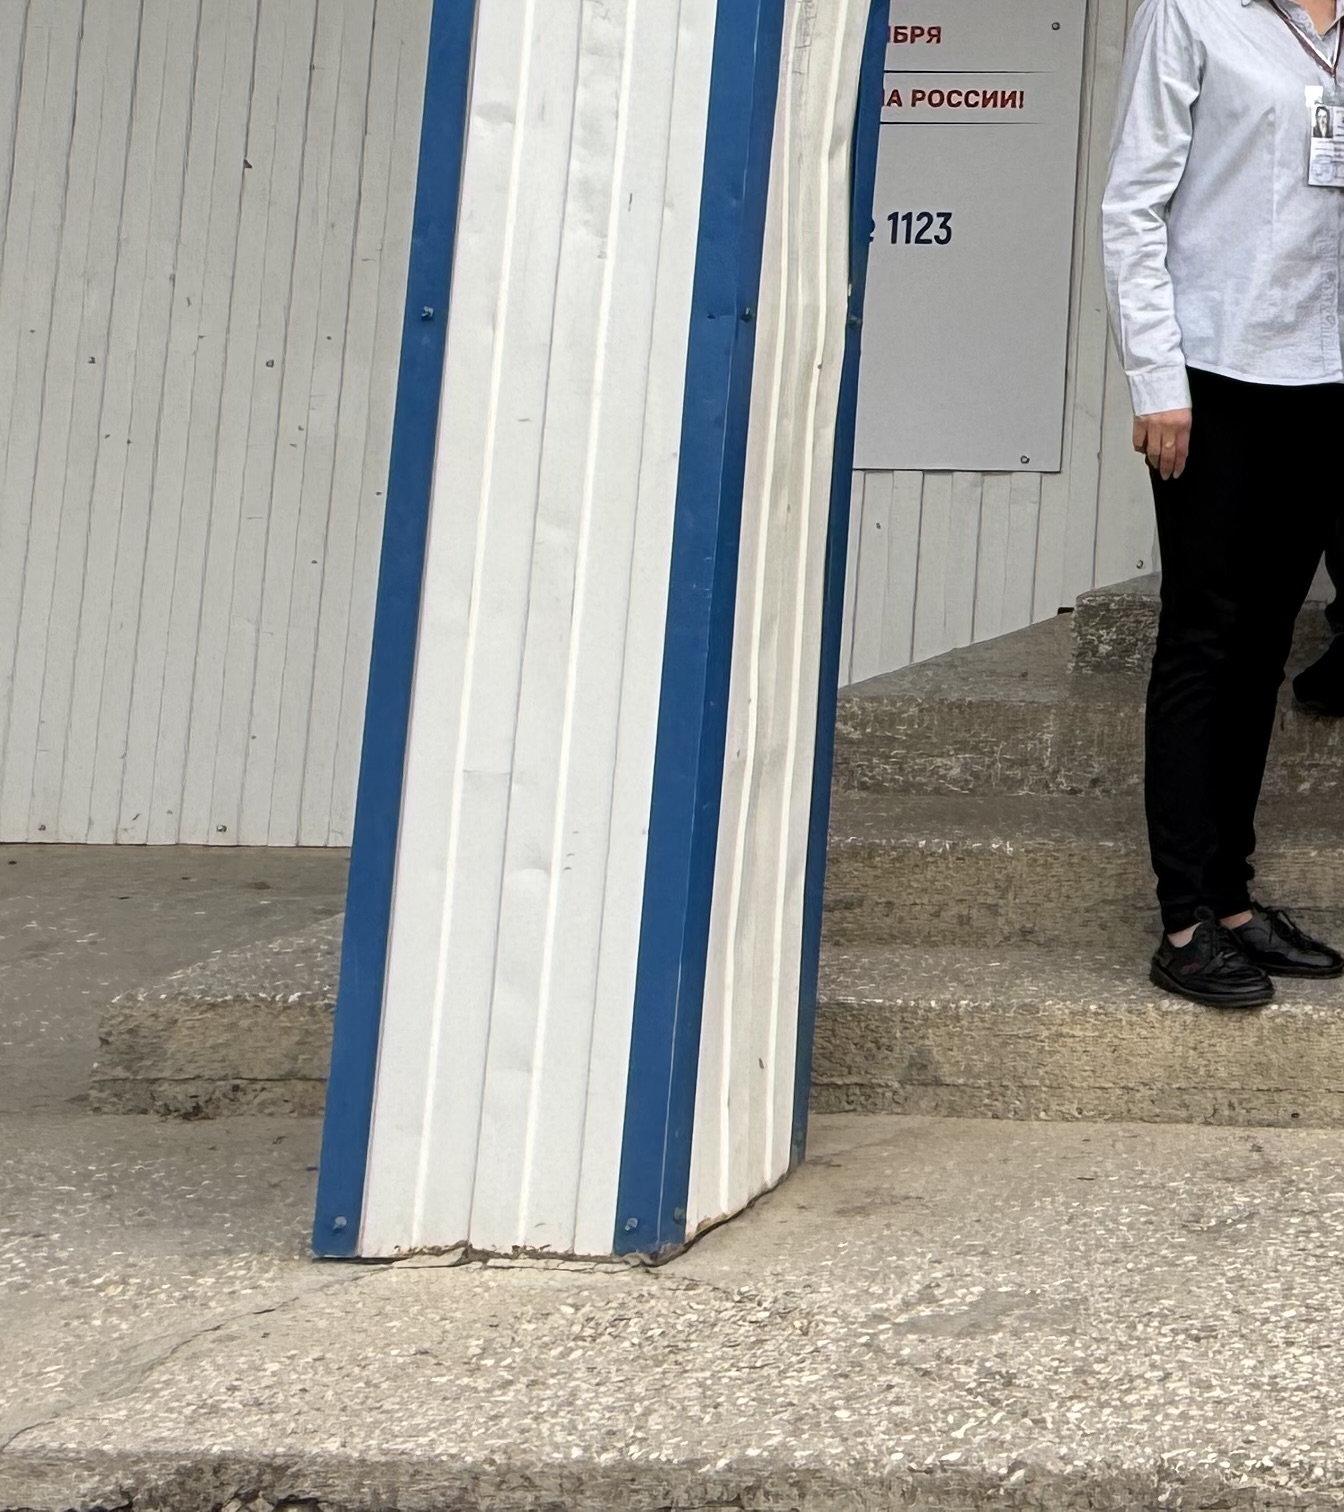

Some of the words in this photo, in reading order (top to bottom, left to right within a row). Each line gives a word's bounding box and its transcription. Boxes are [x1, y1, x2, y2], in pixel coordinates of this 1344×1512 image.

[882, 88, 903, 108] А
[911, 88, 1025, 109] РОССИИ!
[887, 211, 953, 245] 1123
